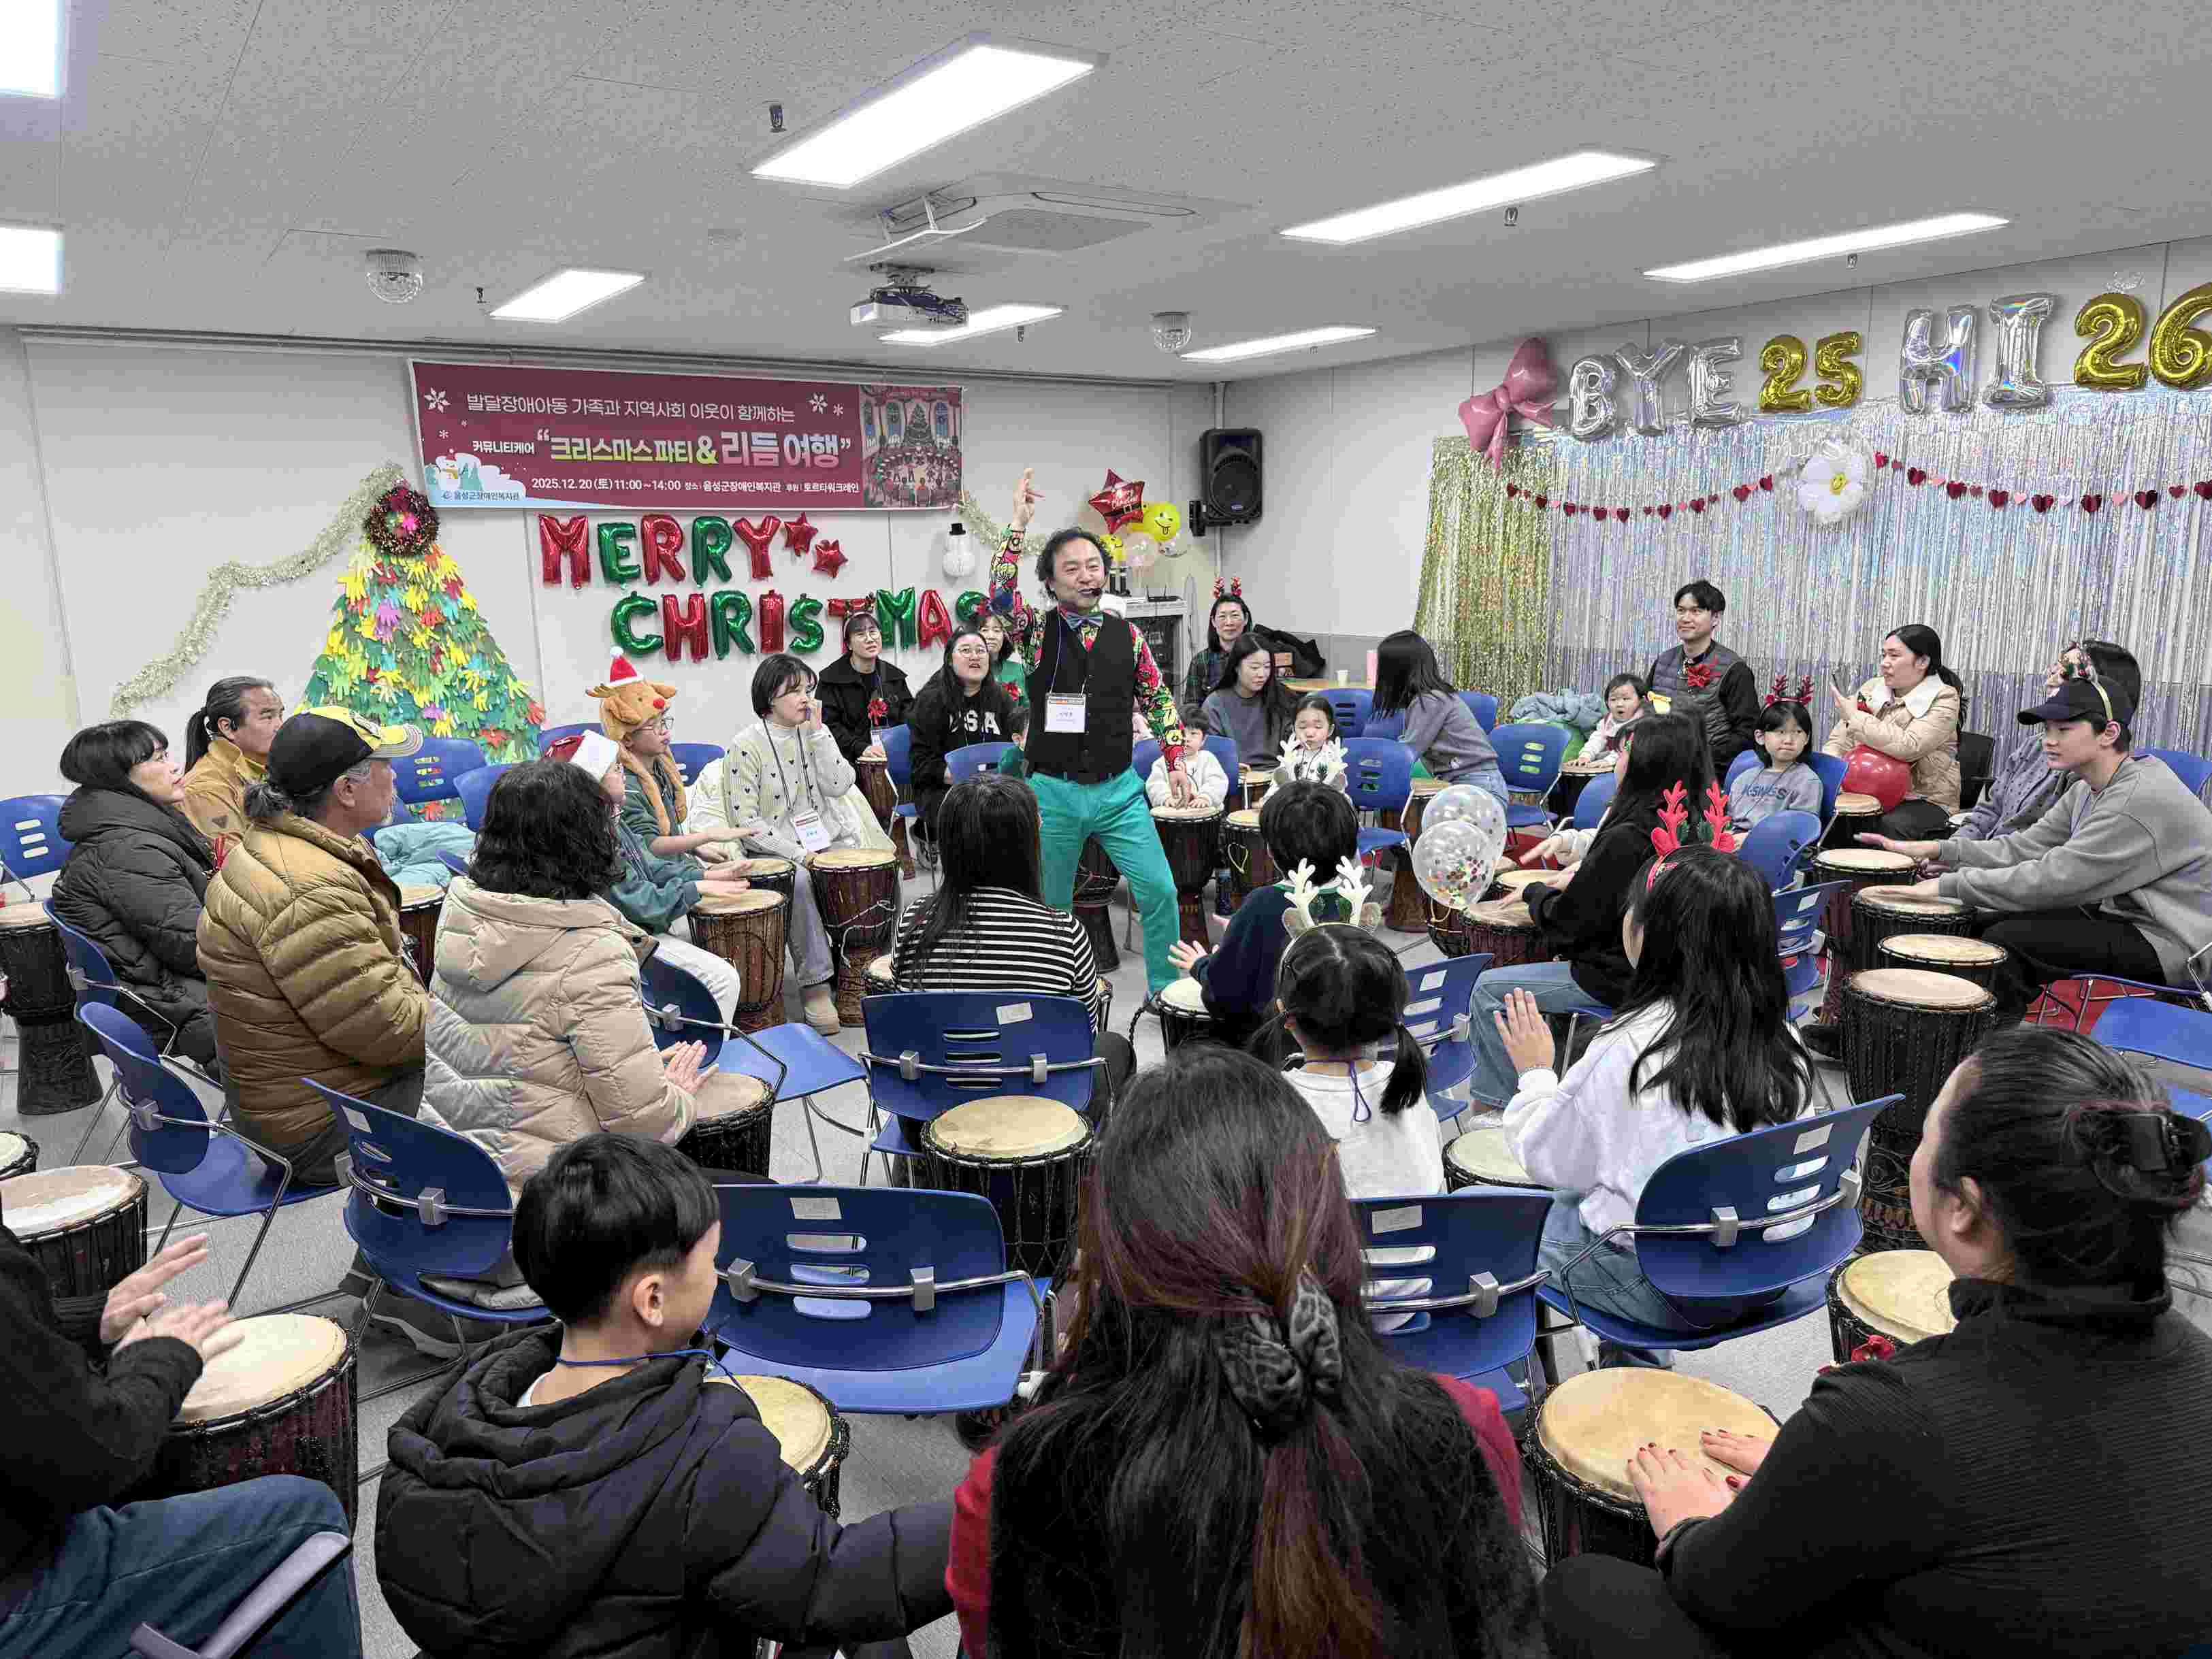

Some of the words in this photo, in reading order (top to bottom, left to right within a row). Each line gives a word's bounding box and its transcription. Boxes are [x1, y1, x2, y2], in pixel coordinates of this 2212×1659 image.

[1569, 336, 1742, 441] BYE
[1759, 331, 1862, 413] 25
[1900, 293, 2056, 413] HI
[2074, 283, 2212, 392] 26
[467, 393, 568, 414] 발달장애아동
[572, 398, 621, 416] 가족과
[624, 401, 686, 418] 지역사회
[689, 402, 734, 420] 이웃이
[738, 404, 796, 423] 함께하는
[472, 440, 535, 455] 커뮤니티케어
[703, 480, 781, 493] 음성군장애인복지관
[538, 514, 782, 587] MERRY
